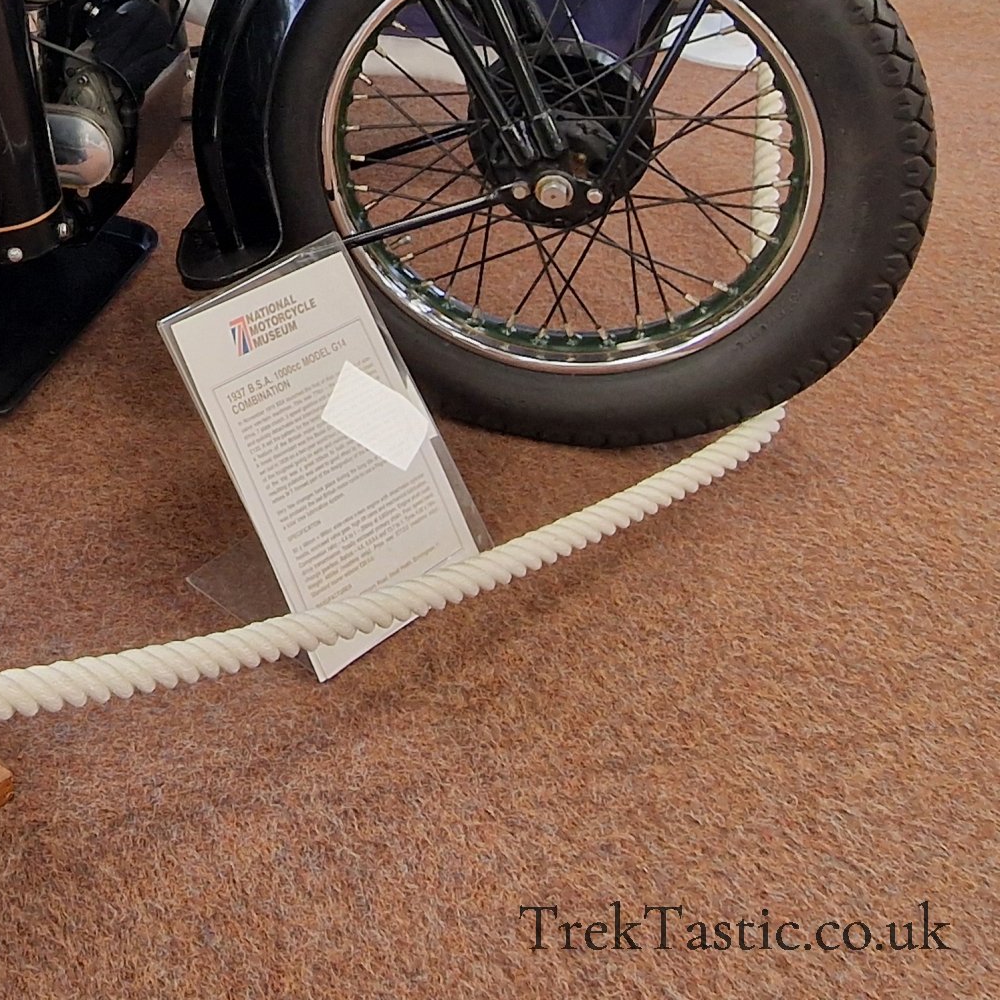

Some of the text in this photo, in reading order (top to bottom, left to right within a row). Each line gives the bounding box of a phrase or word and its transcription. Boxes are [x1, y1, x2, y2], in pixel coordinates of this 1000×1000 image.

[245, 294, 297, 324] NATIONAL
[249, 298, 317, 336] MOTORCYCLE
[253, 320, 298, 348] MUSEUM
[226, 387, 246, 403] 1937
[273, 362, 302, 380] 1000cc
[301, 347, 331, 367] MODEL
[231, 379, 291, 415] COMBINATION
